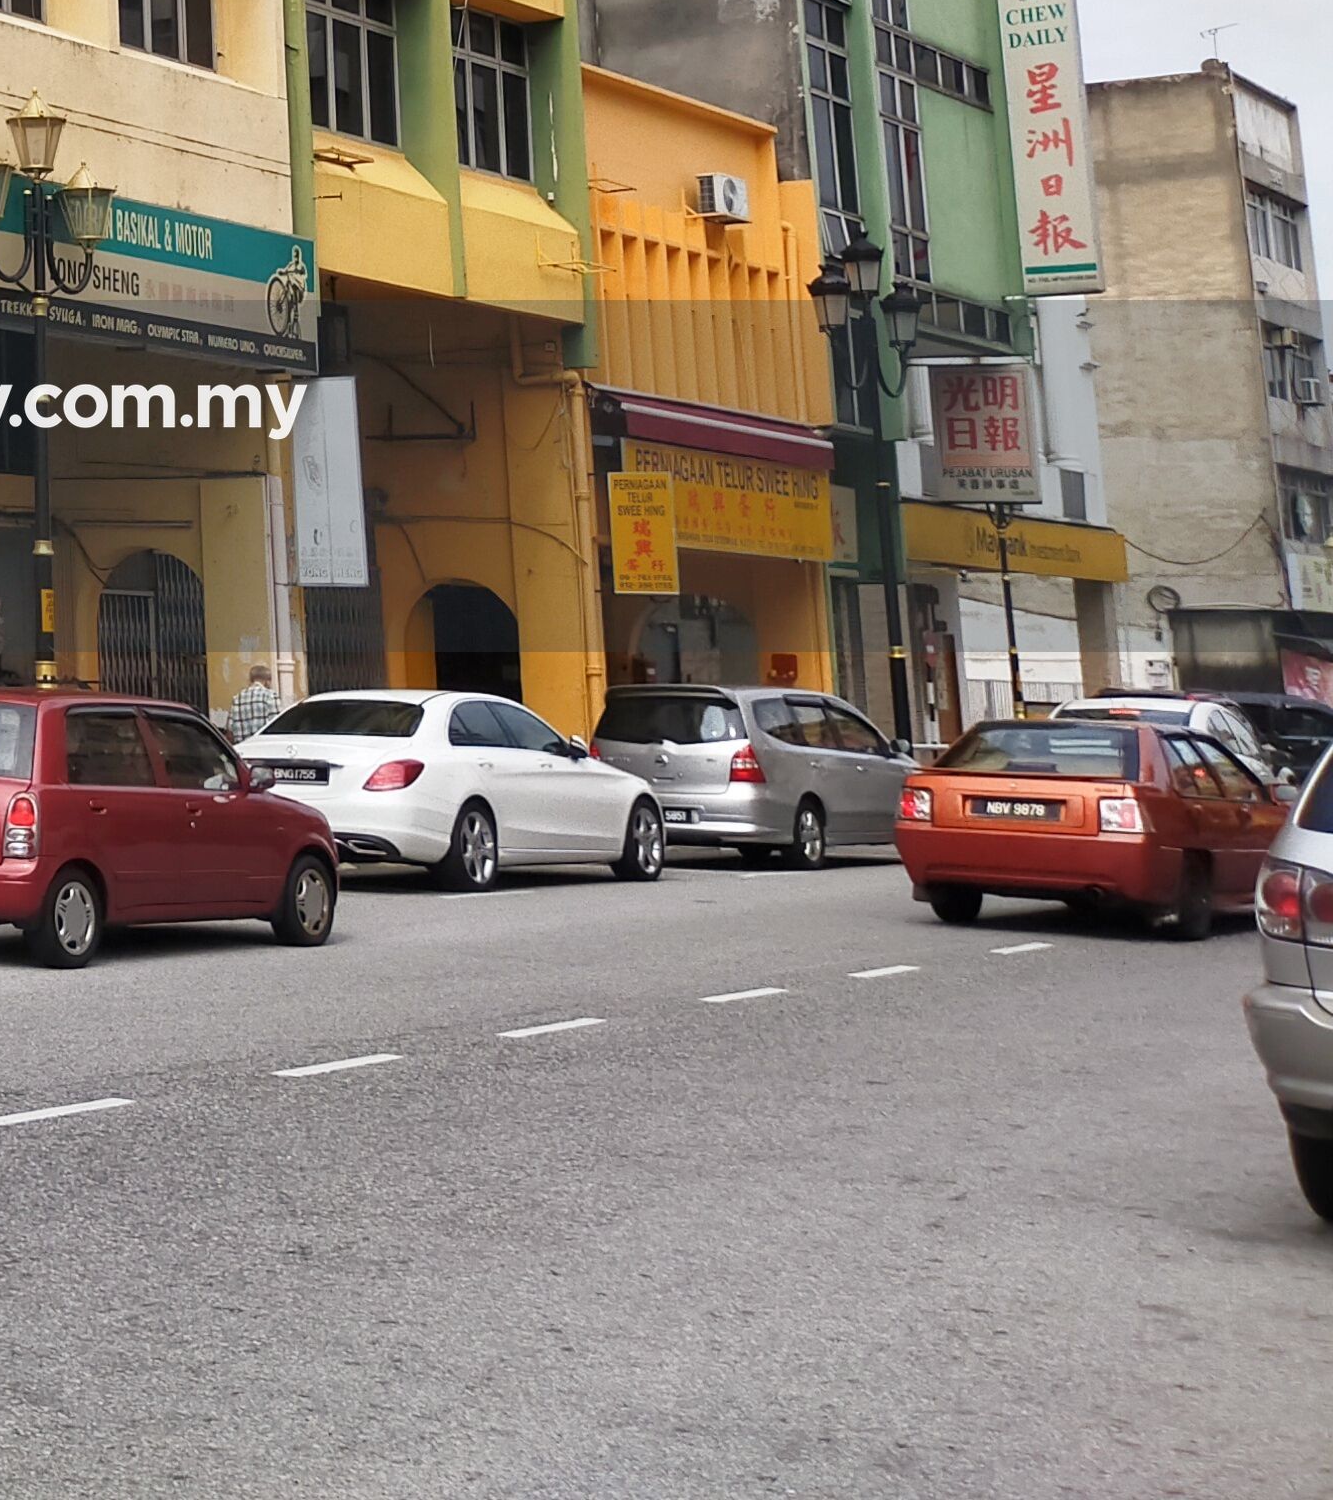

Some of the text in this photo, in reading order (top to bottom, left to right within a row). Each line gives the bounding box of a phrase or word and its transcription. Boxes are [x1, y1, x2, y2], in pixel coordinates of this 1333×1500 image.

[1005, 3, 1067, 26] CHEW
[1008, 26, 1068, 49] DAILY
[116, 209, 161, 249] BASIKAL
[164, 219, 173, 253] &
[175, 221, 213, 260] MOTOR
[93, 264, 140, 297] SHENG
[92, 313, 115, 330] IRON
[943, 375, 1020, 412] 光明
[946, 416, 1021, 451] 日報
[716, 460, 756, 492] TELUR
[757, 467, 789, 496] SWEE
[617, 505, 642, 516] SWEE
